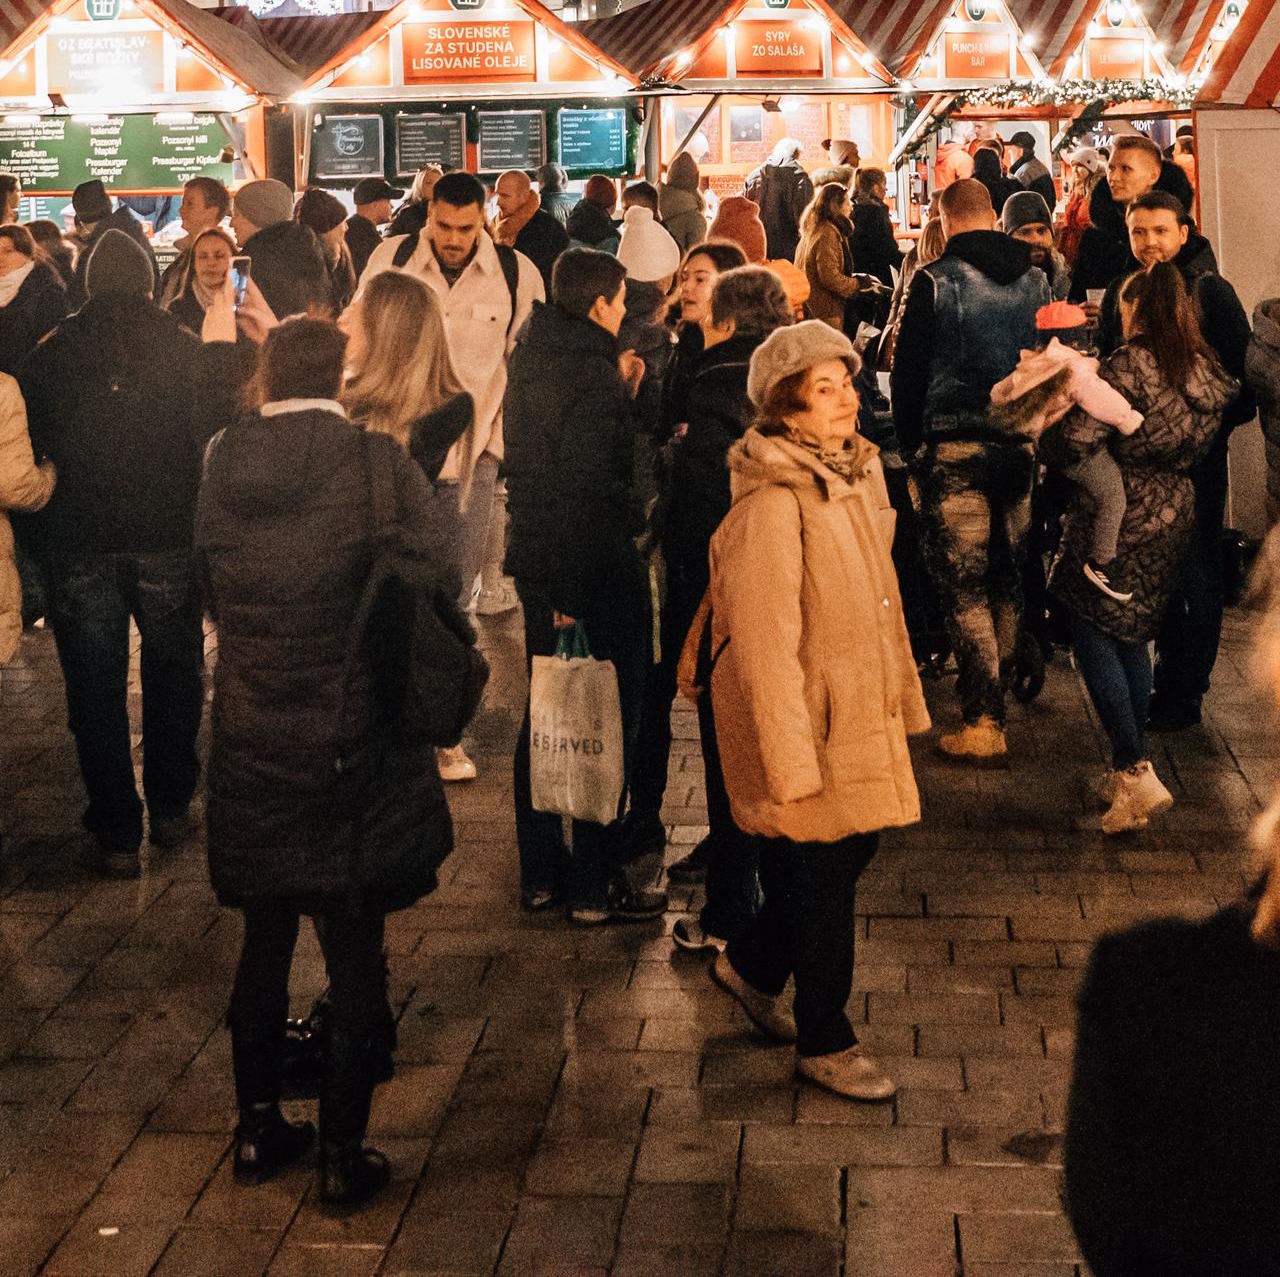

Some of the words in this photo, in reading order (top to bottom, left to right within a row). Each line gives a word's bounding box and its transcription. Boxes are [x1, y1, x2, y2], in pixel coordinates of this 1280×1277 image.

[427, 23, 510, 39] SLOVENSKÉ
[765, 31, 791, 42] SYRY
[424, 42, 444, 54] ZA
[447, 41, 515, 54] STUDENA
[752, 45, 766, 56] ZO
[767, 43, 806, 56] SALAŠA
[952, 42, 978, 53] PUNCH
[412, 54, 481, 70] LISOVANÉ
[484, 55, 528, 68] OLEJE
[971, 56, 986, 67] BAR
